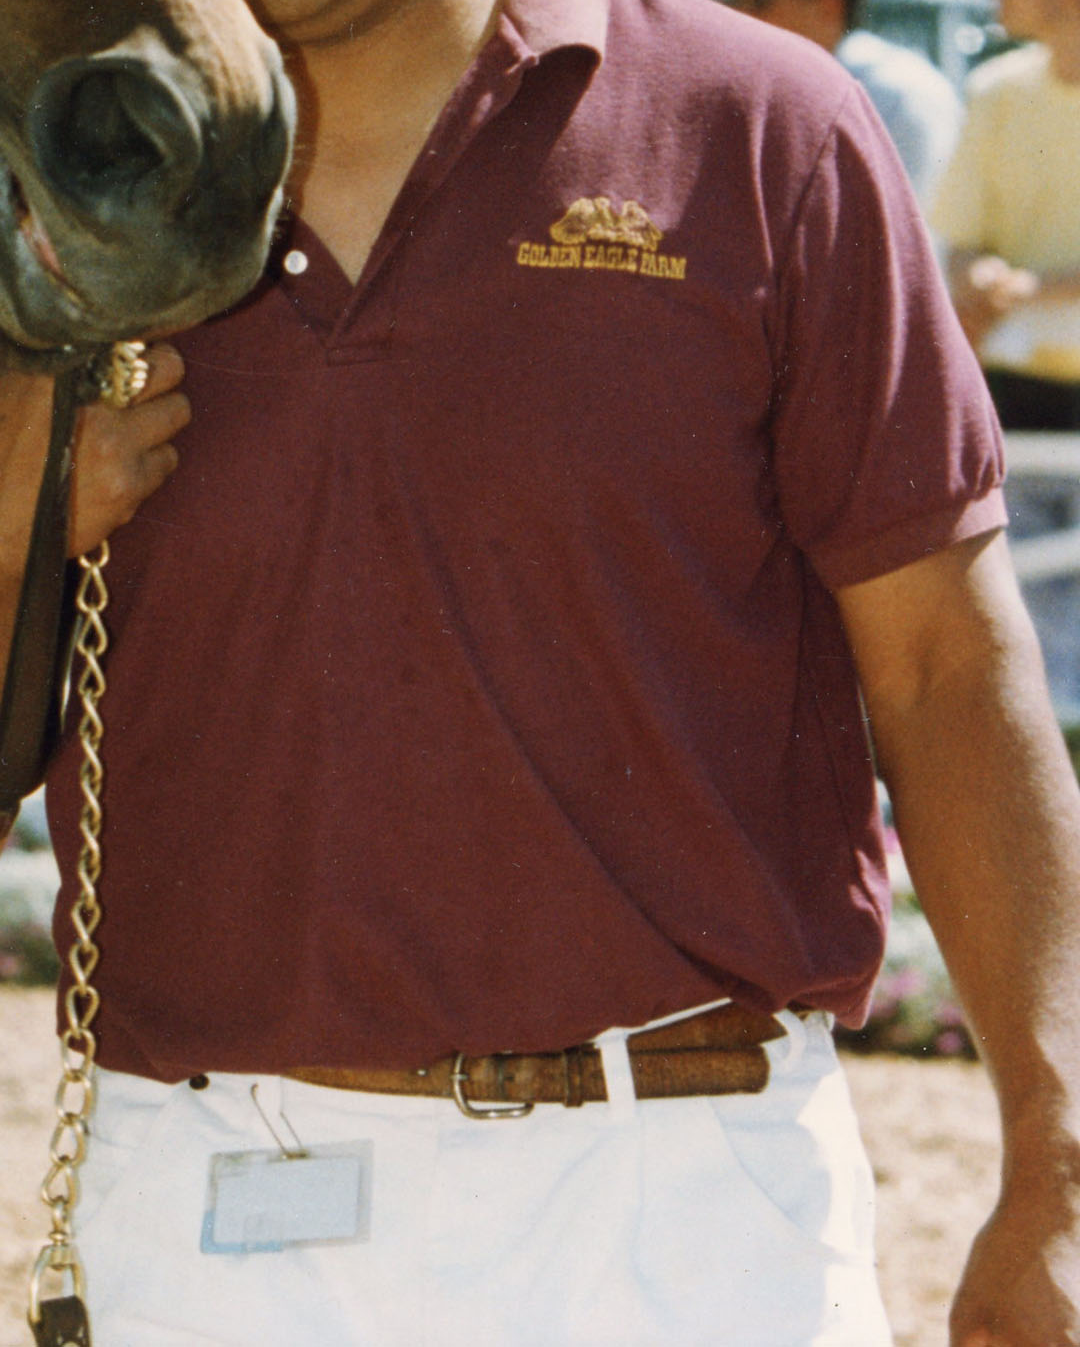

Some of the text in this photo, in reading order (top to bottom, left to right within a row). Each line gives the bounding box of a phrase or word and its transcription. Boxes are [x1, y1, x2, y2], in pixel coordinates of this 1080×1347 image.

[517, 241, 687, 280] GOLDEN EAGLE FARM
